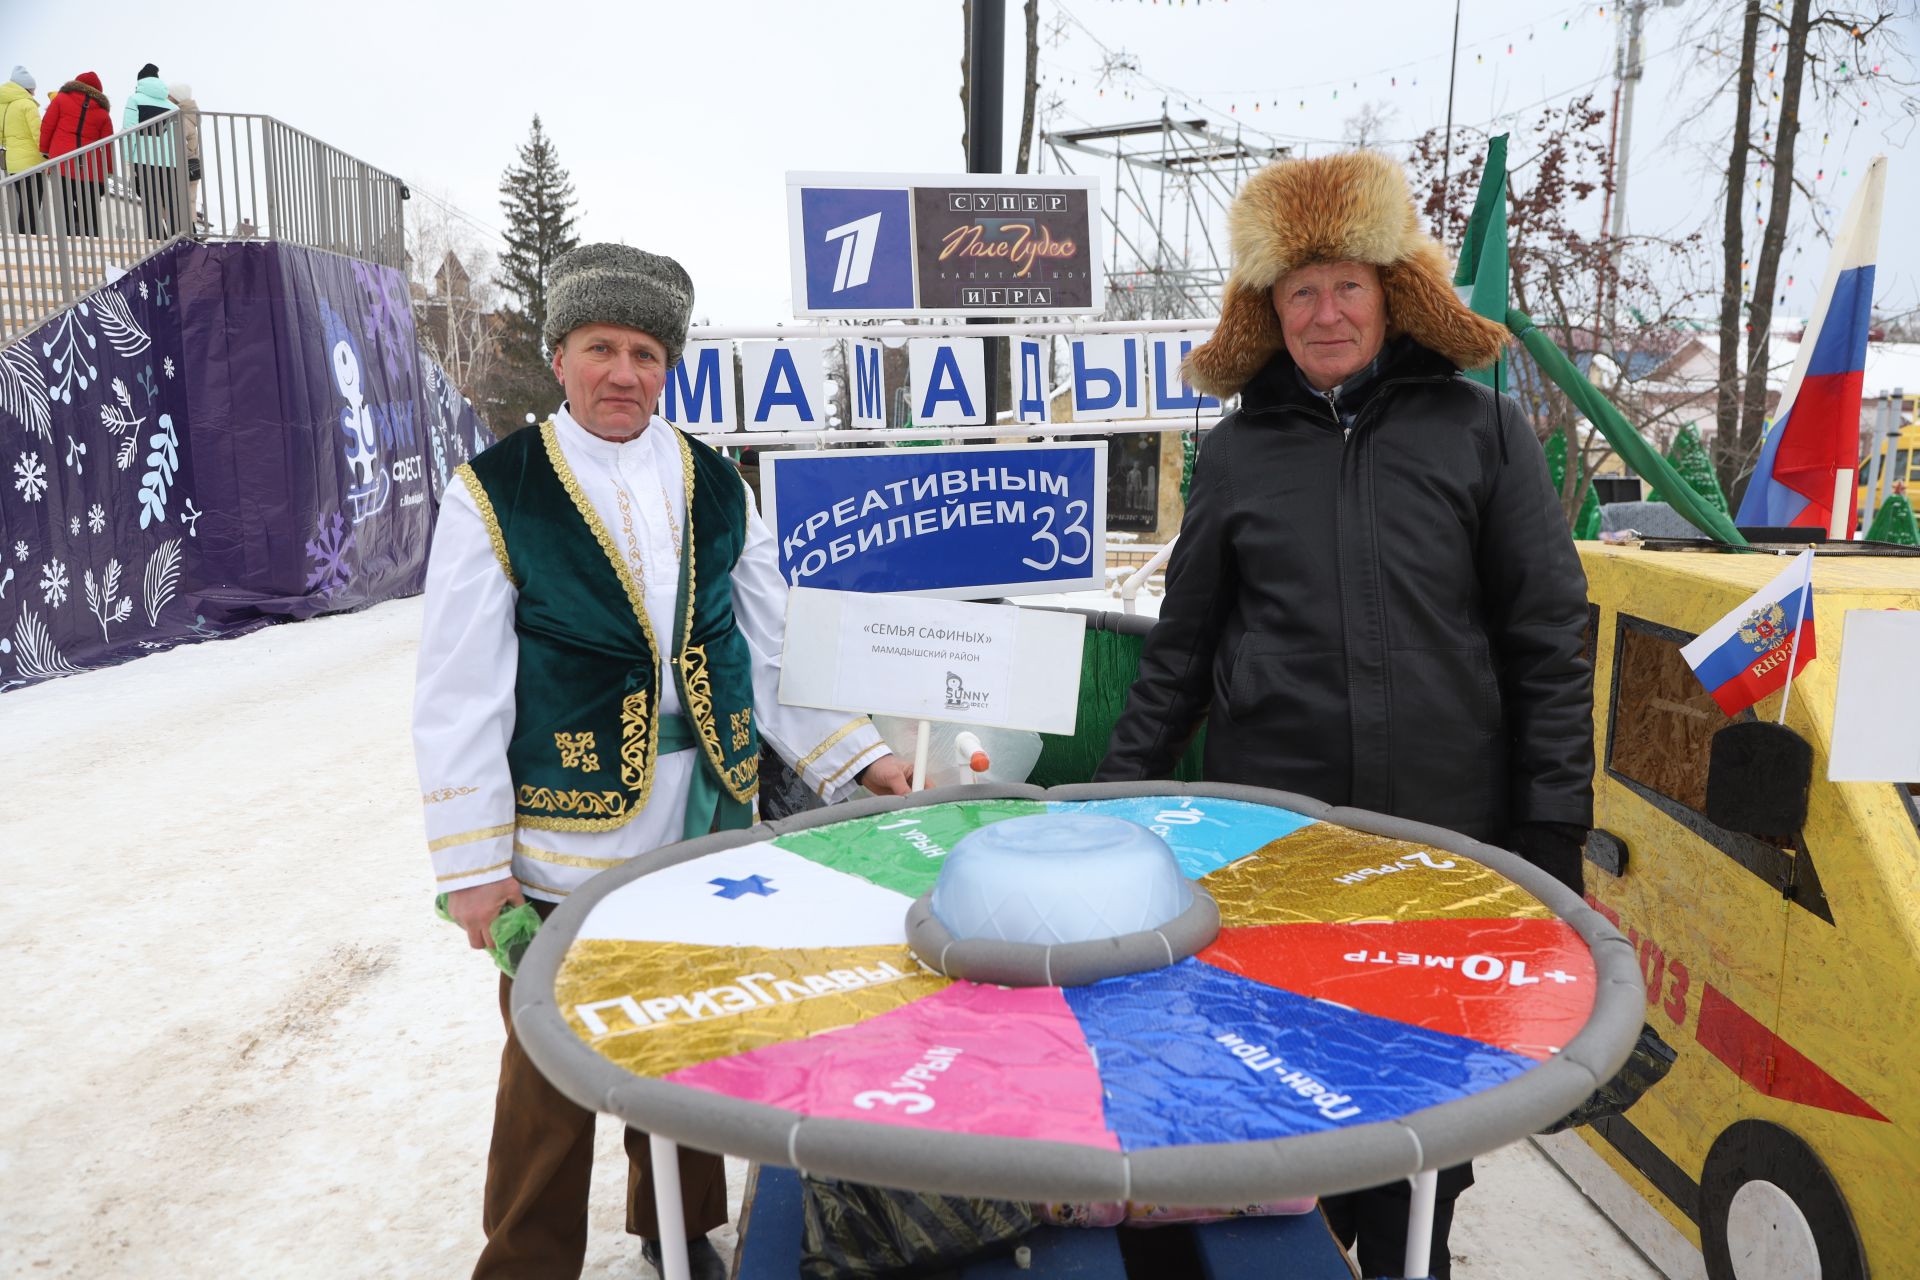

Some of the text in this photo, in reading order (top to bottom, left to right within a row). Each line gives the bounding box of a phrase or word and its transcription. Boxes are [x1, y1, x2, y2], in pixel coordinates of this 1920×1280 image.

[953, 196, 1062, 210] СУПЕР
[938, 224, 1076, 277] Поле Чудес
[967, 290, 1047, 304] ИГРА
[393, 455, 421, 483] ФЕСТ
[783, 467, 1068, 561] КРЕАТИВНЫМ
[790, 499, 1091, 587] ЮБИЛЕЙЕМ 33
[864, 623, 992, 643] «СЕМЬЯ САФИНЫХ»
[871, 645, 980, 662] МАМАДЫШСКИЙ РАЙОН
[1403, 851, 1456, 870] 2
[1343, 950, 1454, 969] МЕТР
[1216, 1033, 1361, 1120] Гран-При
[854, 1090, 935, 1115] 3
